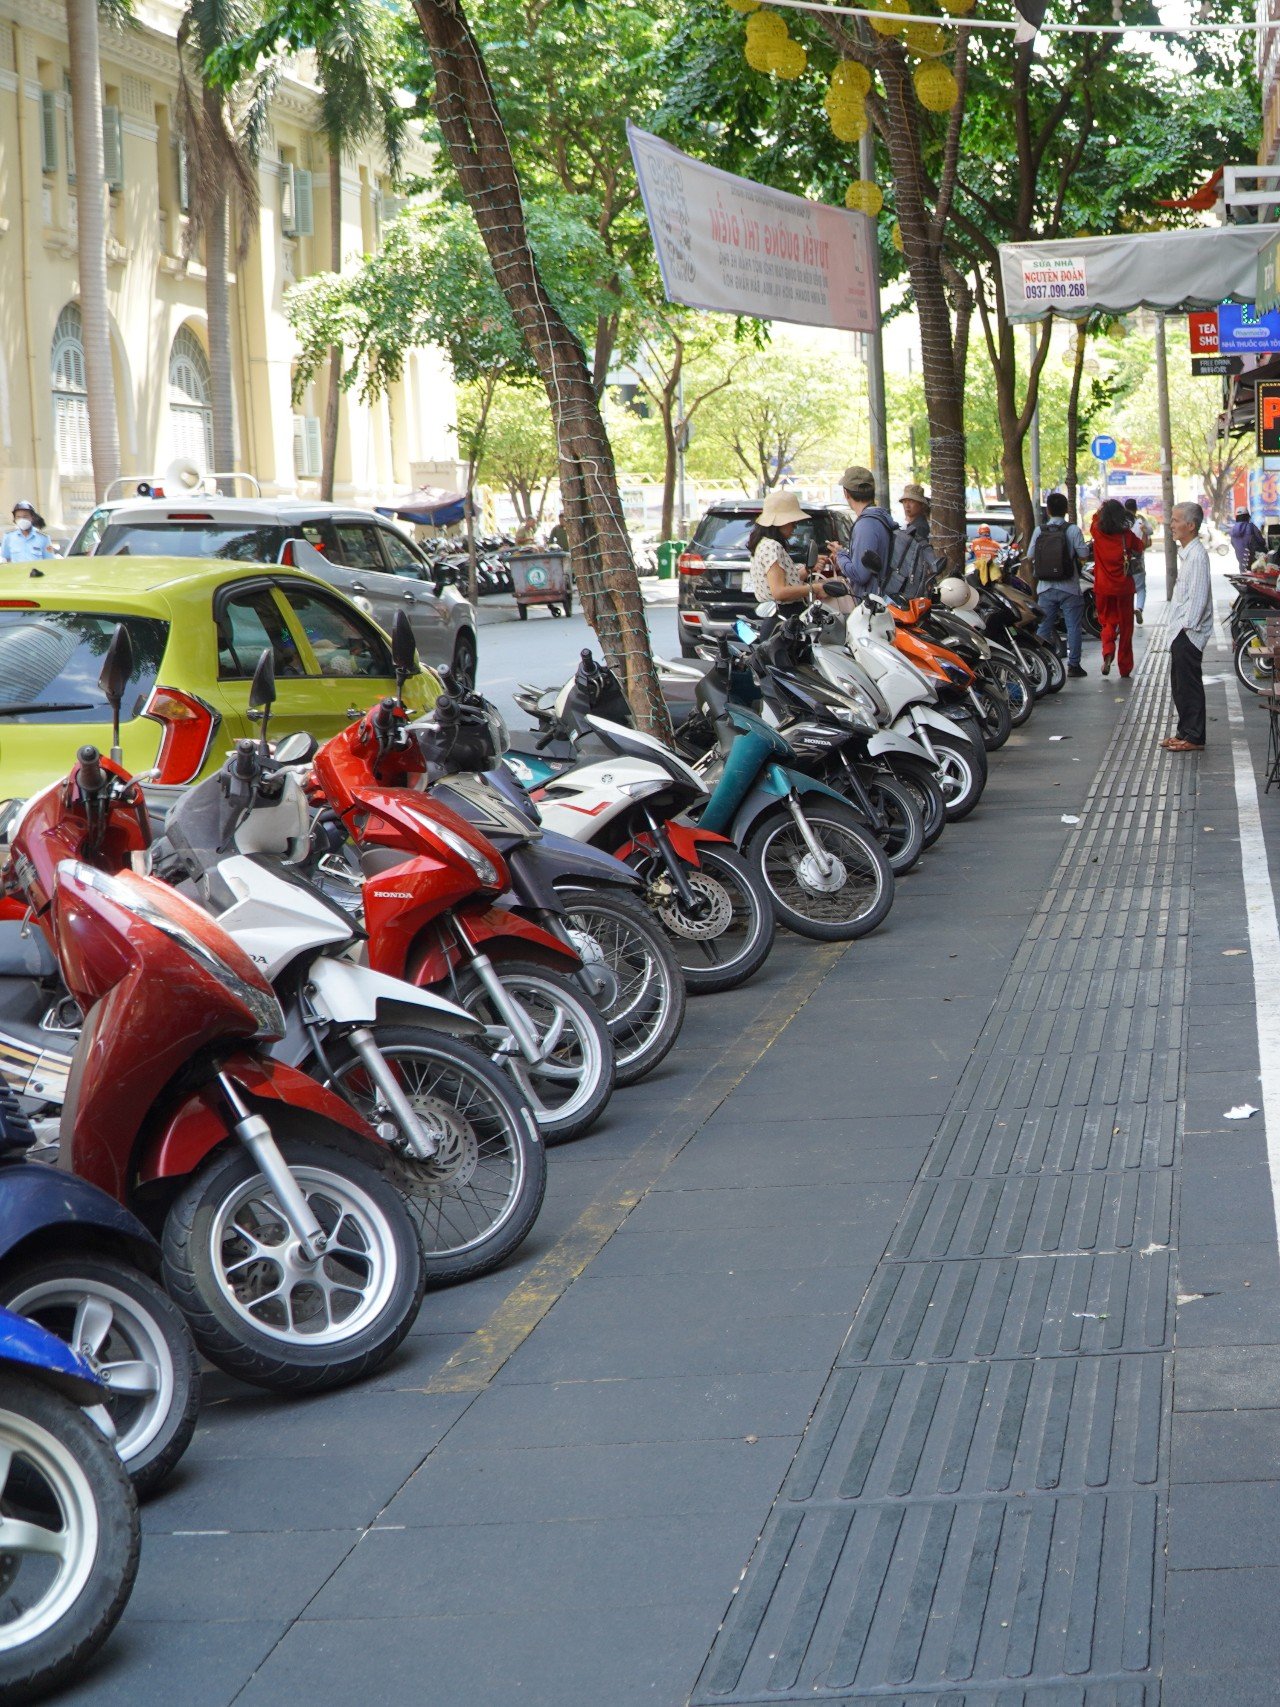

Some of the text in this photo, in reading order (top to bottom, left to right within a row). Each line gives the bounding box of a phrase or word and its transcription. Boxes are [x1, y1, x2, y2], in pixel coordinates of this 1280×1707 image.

[1025, 283, 1085, 299] 0937.090.268
[1198, 323, 1217, 334] TEA
[1199, 336, 1219, 346] SHO
[803, 737, 833, 747] HONDA
[373, 891, 414, 899] HONDA
